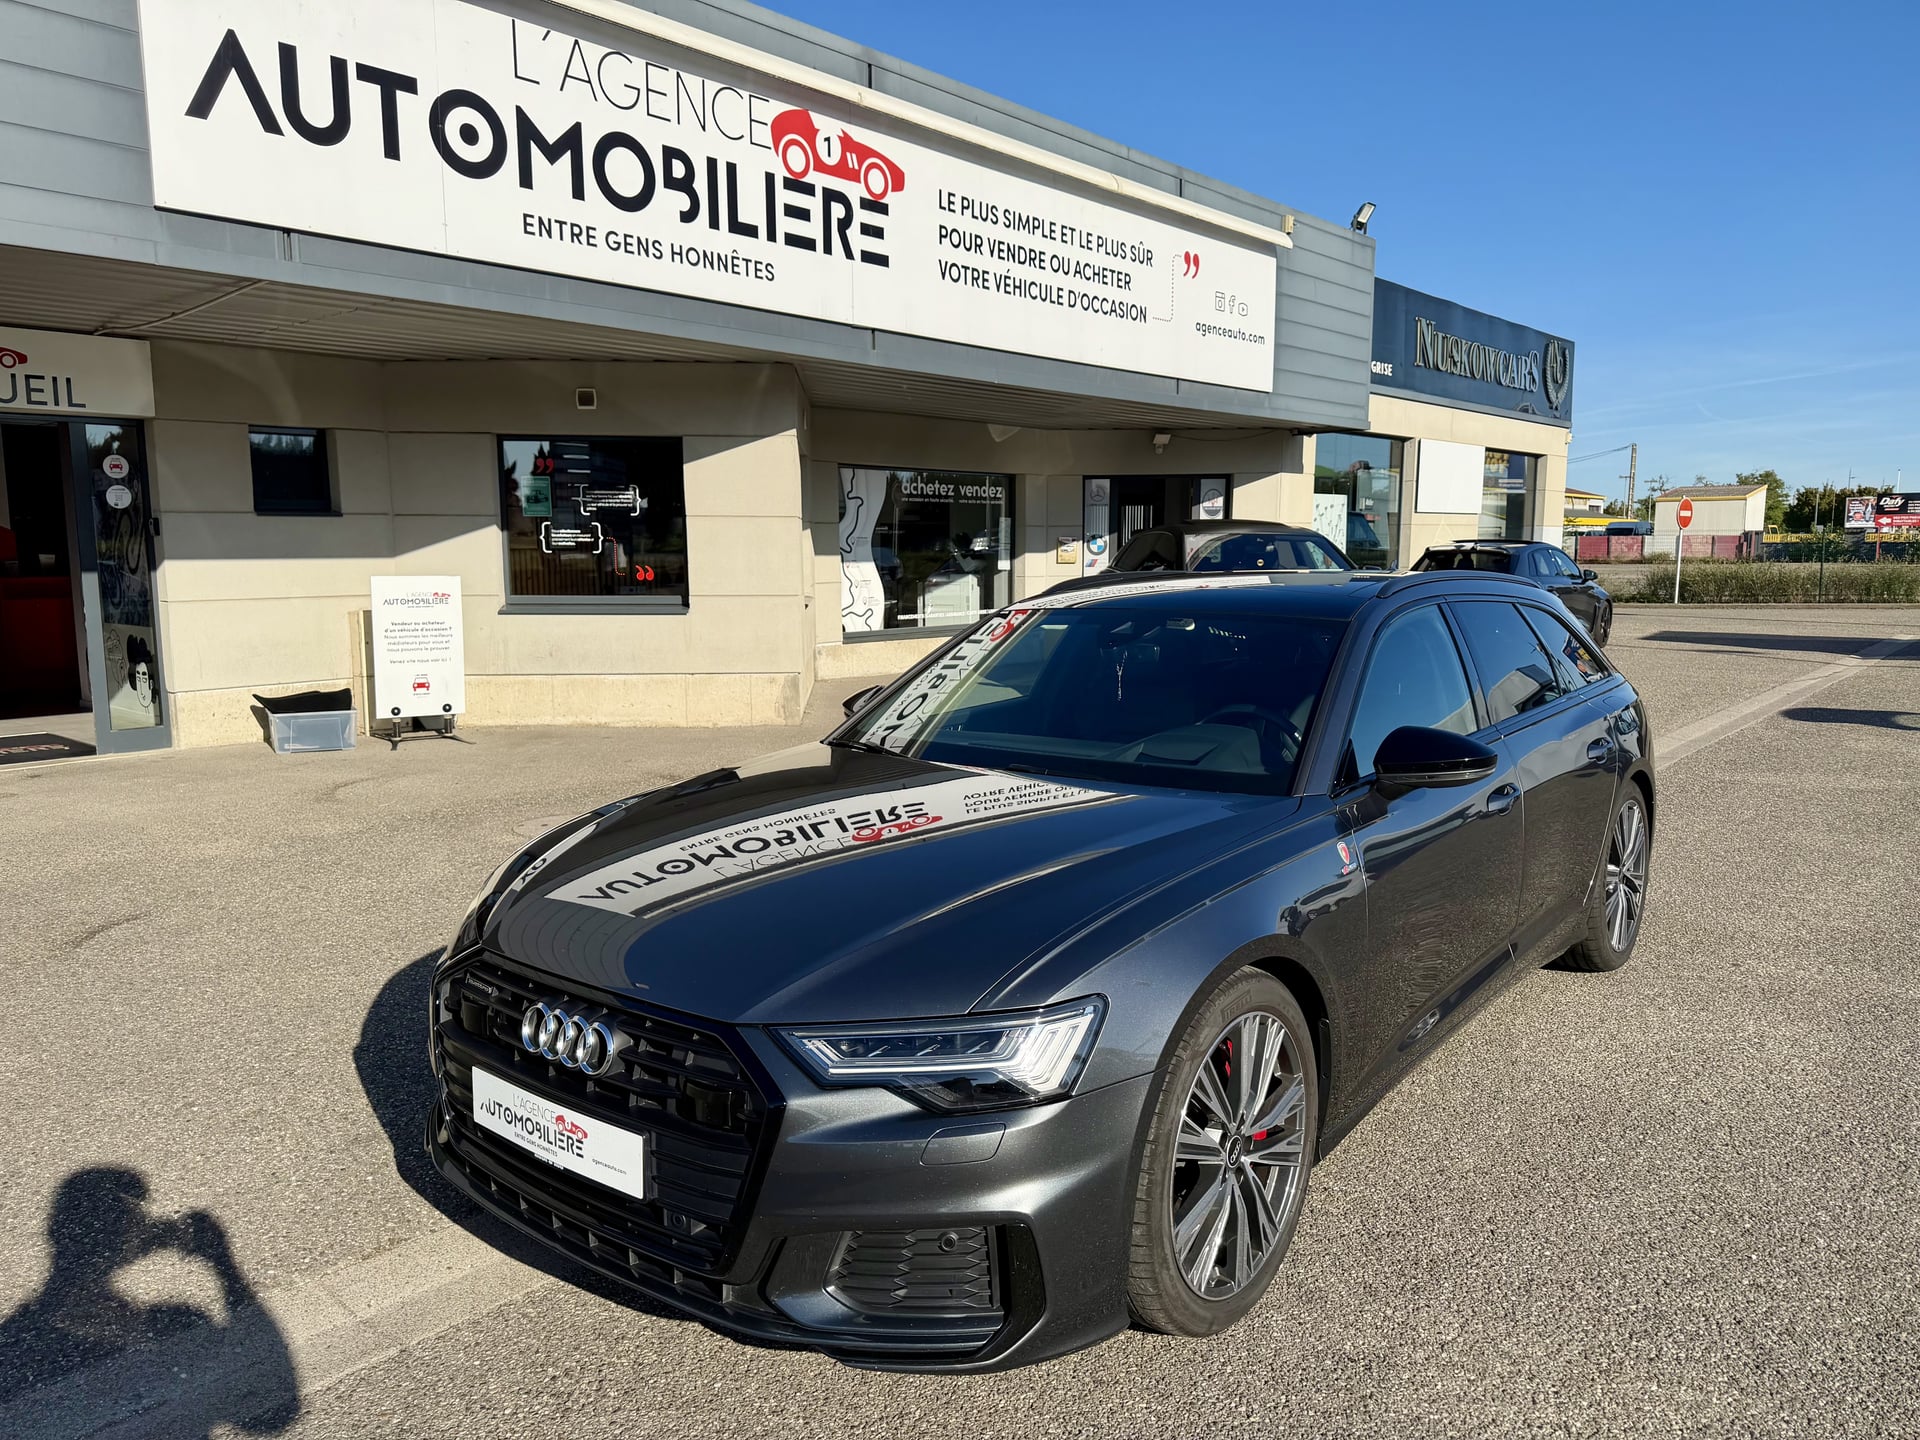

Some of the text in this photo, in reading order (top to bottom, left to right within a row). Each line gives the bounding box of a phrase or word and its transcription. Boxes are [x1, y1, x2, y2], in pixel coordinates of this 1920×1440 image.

[512, 19, 771, 149] L'AGENCE
[184, 28, 889, 268] AUTOMOBILIERE
[522, 213, 775, 281] ENTRE GENS HONNÊTES
[939, 189, 1153, 267] LE PLUS SIMPLE ET LE PLUS SÛR
[939, 224, 1132, 291] POUR VENDRE OU ACHETER
[938, 259, 1147, 324] VOTRE VÉHICULE D'OCCASION
[1195, 321, 1265, 345] agenceauto.com
[1371, 360, 1393, 377] GRISE
[901, 475, 955, 496] achetez
[959, 476, 1003, 498] vendez
[480, 1097, 584, 1159] AUTOMOBILIERE
[512, 1093, 556, 1125] L'AGENCE
